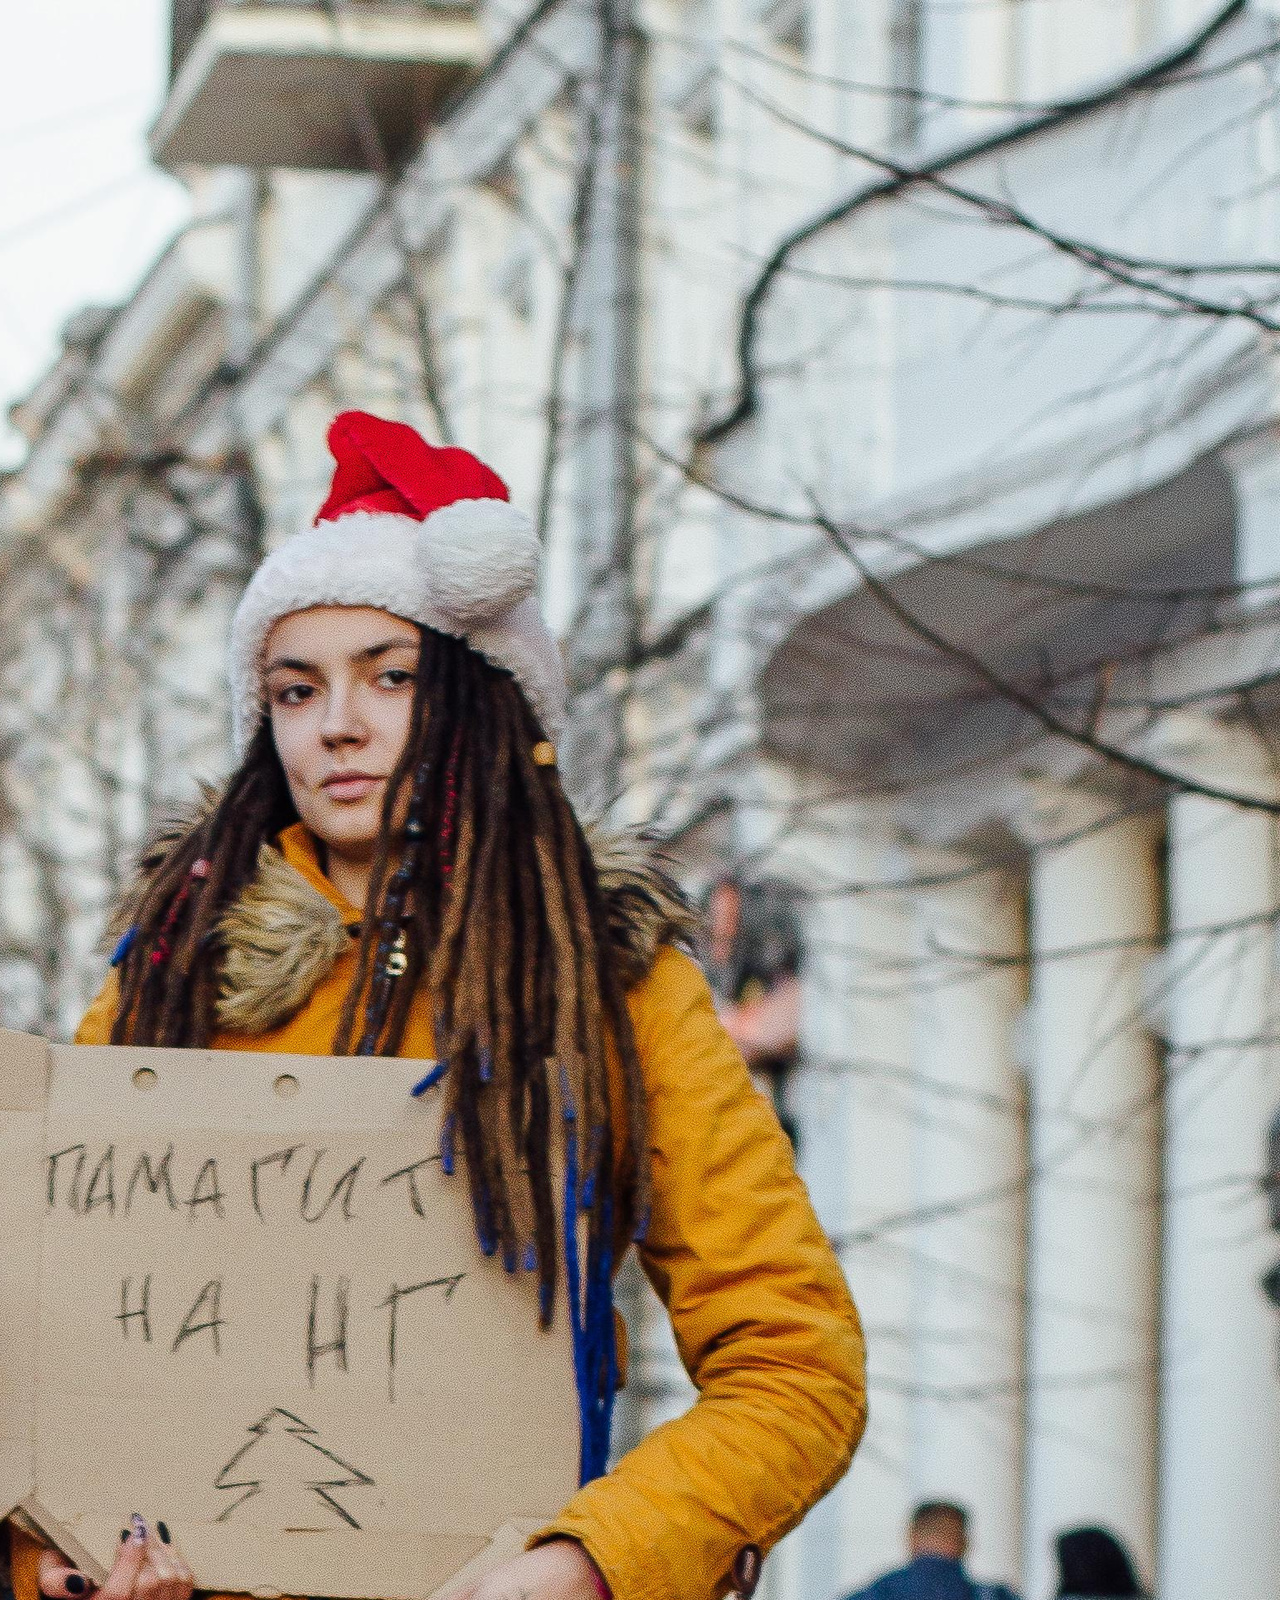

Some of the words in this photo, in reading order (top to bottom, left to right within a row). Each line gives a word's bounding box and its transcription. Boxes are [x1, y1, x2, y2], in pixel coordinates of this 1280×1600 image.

[46, 1143, 536, 1236] ПАМАГИТ
[115, 1273, 226, 1354] НА
[304, 1272, 468, 1402] НГ
